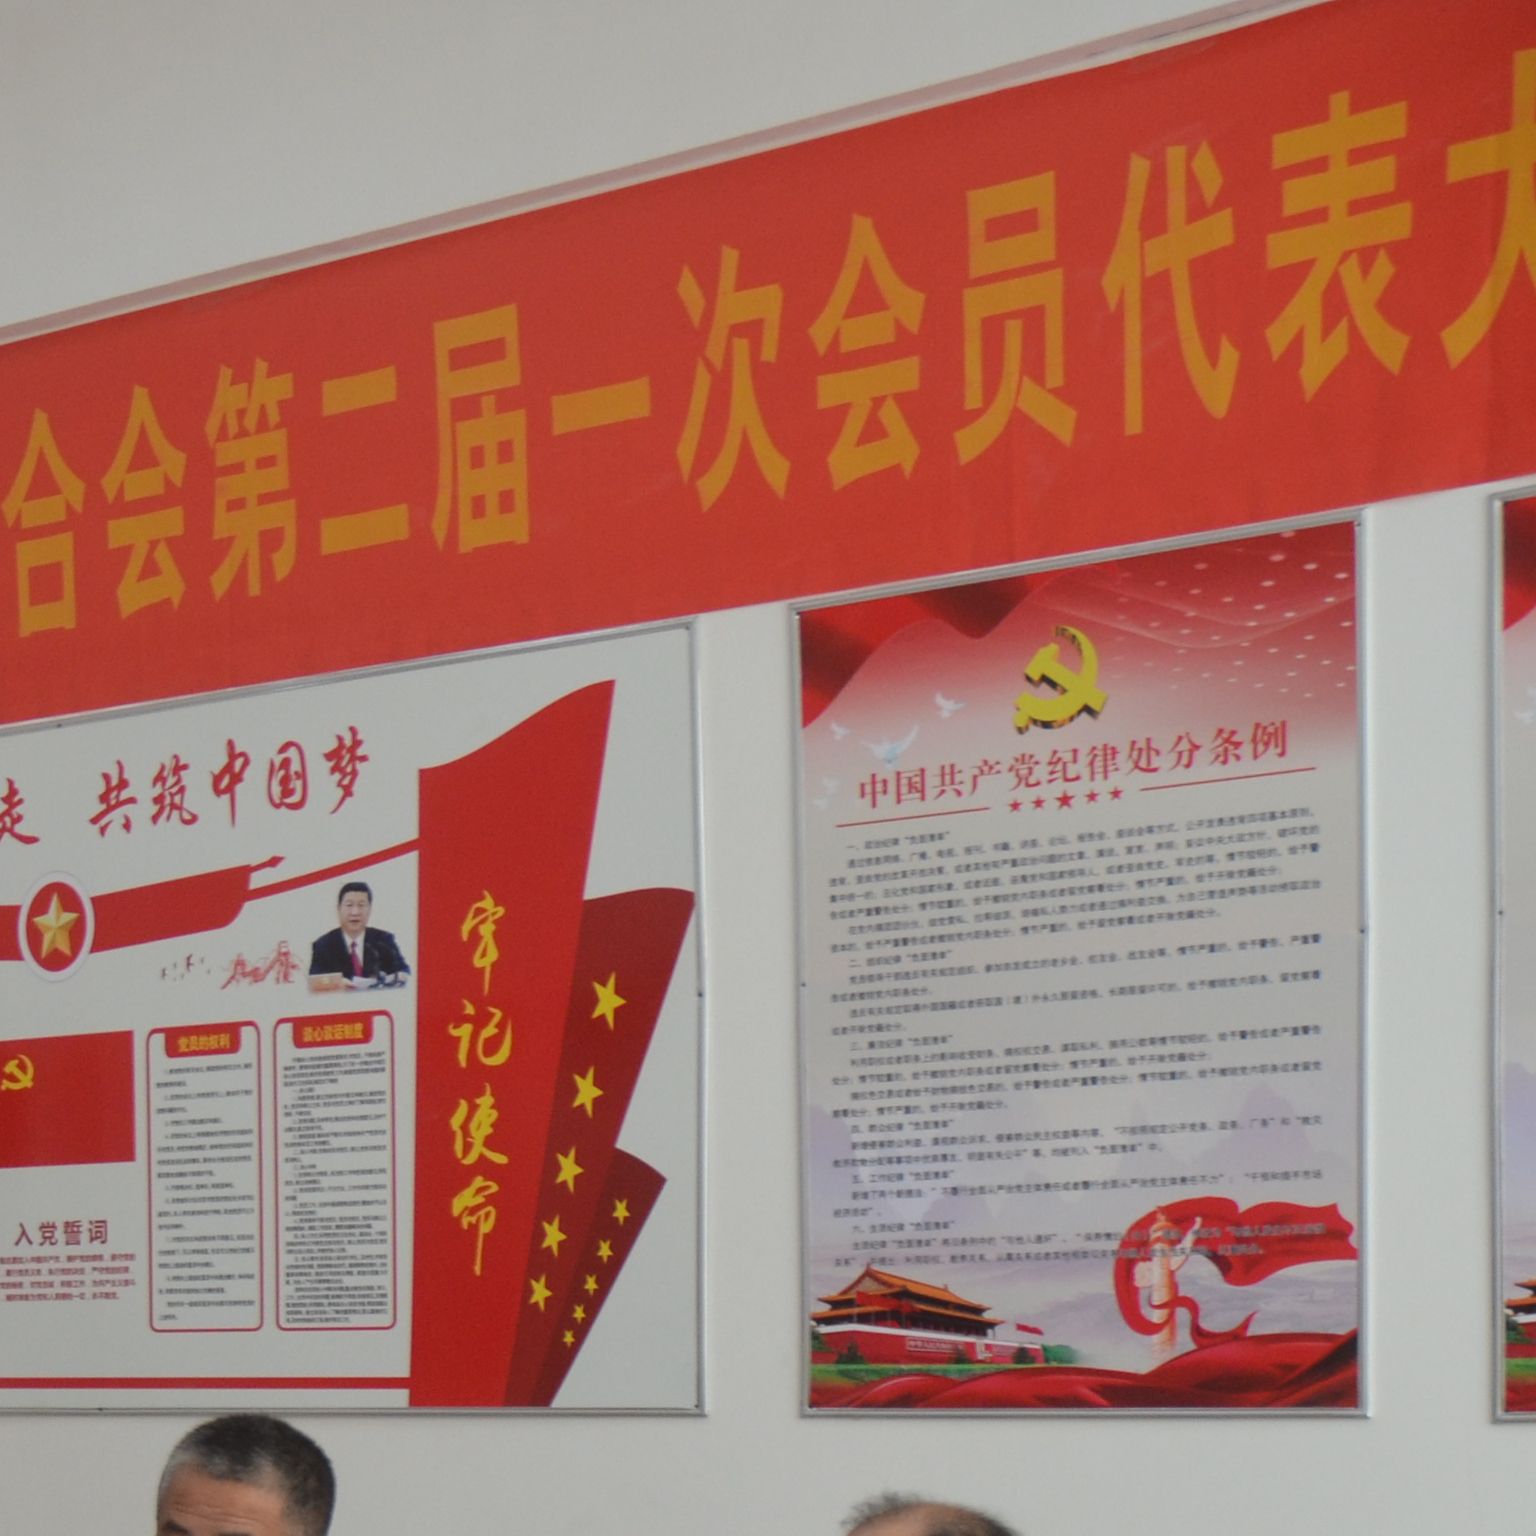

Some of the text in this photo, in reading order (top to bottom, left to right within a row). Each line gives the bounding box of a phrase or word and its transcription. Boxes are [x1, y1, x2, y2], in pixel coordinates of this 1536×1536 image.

[87, 724, 371, 837] 共筑中国梦
[858, 719, 1289, 810] 中国共产党纪律处分条例
[177, 1031, 231, 1053] 党员的权利
[448, 888, 513, 1277] 牢记使命
[14, 1219, 108, 1246] 入党誓词
